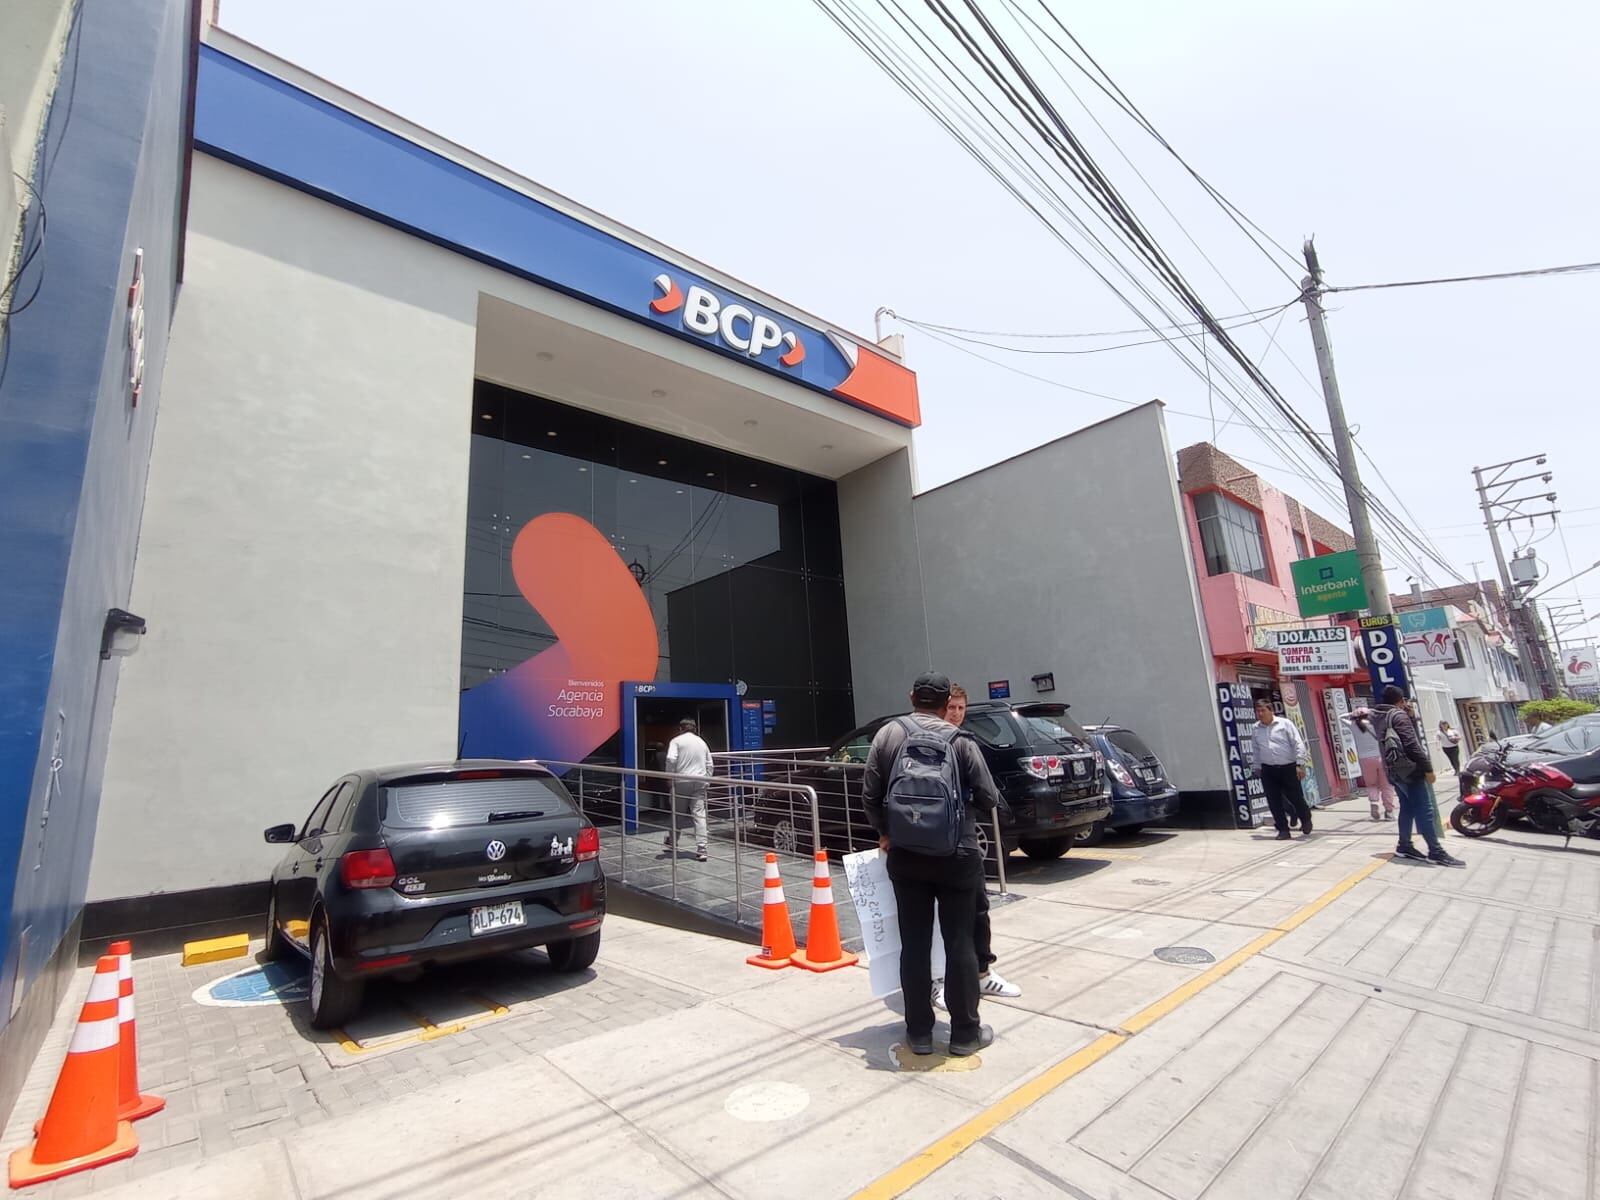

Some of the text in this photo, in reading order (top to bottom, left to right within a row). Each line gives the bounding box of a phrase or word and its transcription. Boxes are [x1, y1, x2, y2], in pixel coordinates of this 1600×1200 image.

[682, 285, 783, 357] BCP
[1301, 577, 1360, 596] Interbank
[1361, 616, 1389, 628] EUROS
[1279, 627, 1345, 644] DOLARES
[1281, 646, 1314, 656] COMPRA
[1285, 655, 1312, 664] VENTA
[557, 689, 604, 703] Agencia
[638, 685, 653, 693] BCP
[1230, 684, 1252, 700] CASA
[548, 705, 603, 720] Socabaya
[1324, 691, 1348, 776] SALTEÑAS
[1468, 706, 1486, 748] DOLAR
[1219, 687, 1250, 822] DOLARES
[473, 907, 521, 929] ALP-674
